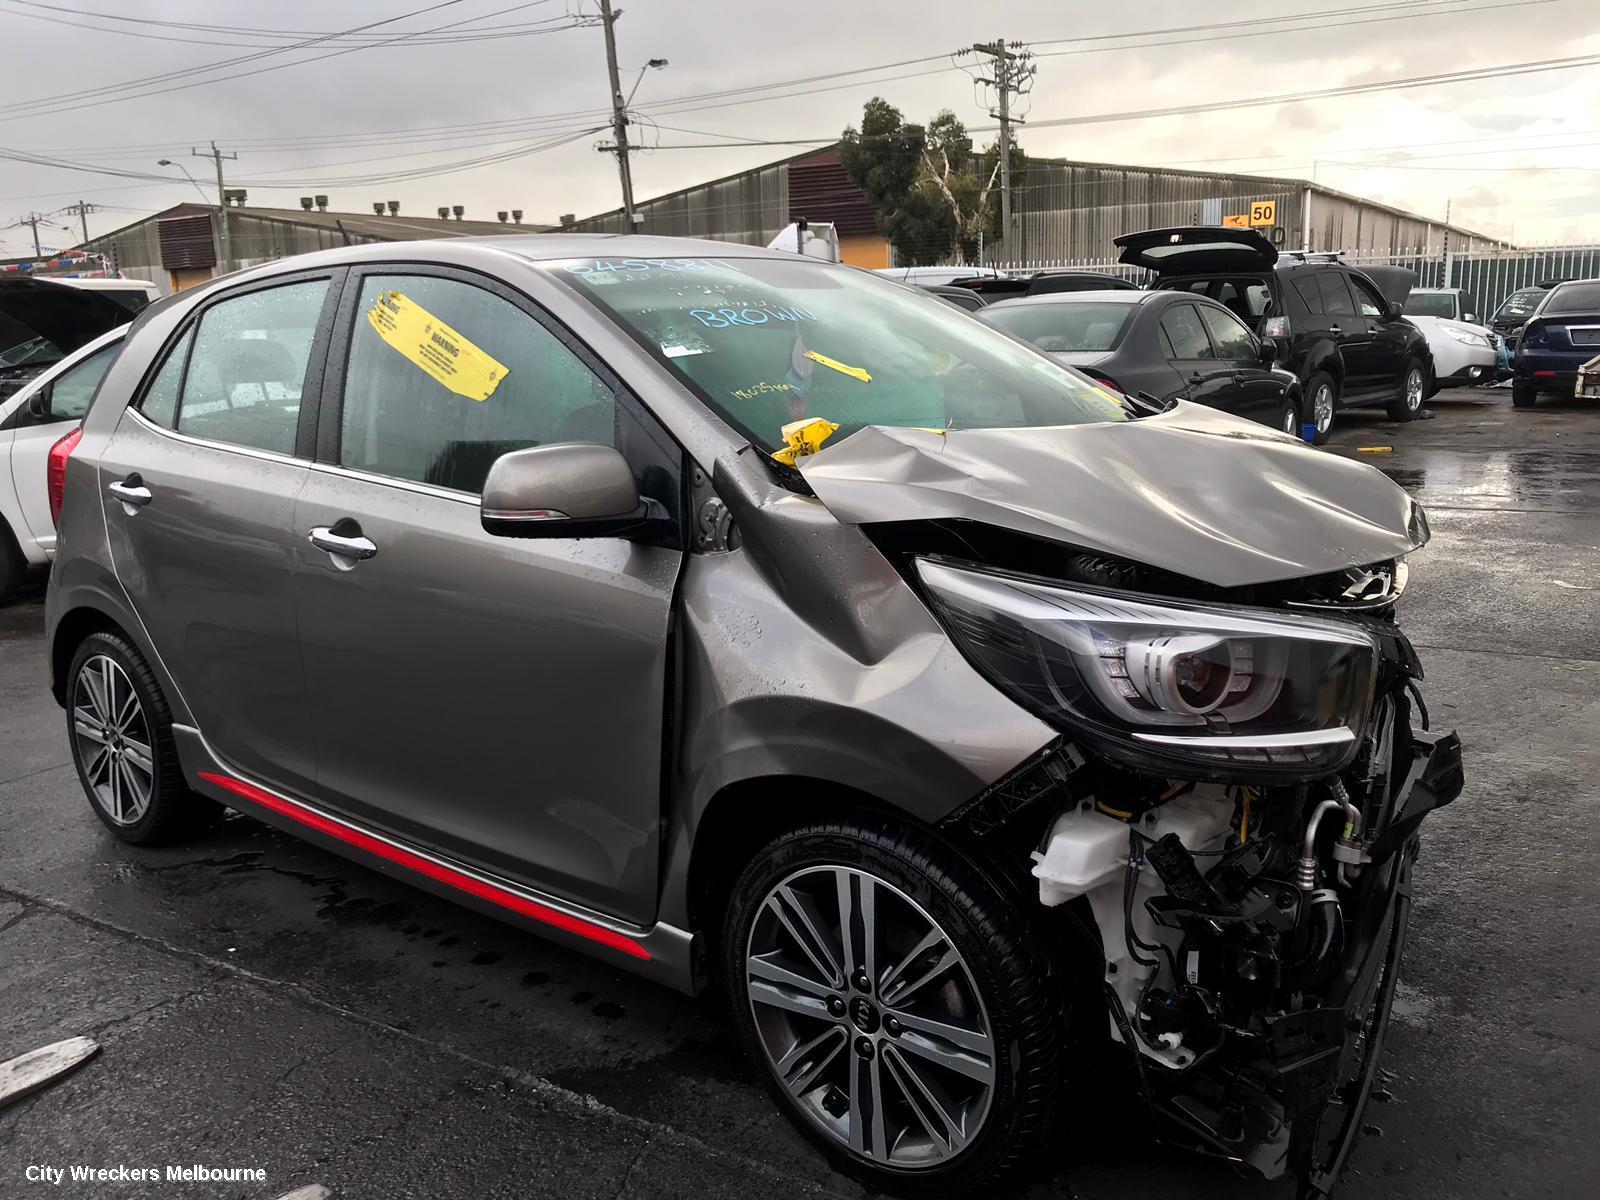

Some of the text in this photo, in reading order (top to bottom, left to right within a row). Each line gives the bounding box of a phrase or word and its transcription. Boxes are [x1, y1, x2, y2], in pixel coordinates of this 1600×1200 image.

[1253, 206, 1272, 220] 50
[690, 306, 817, 328] BROWN
[431, 331, 460, 358] WARNING
